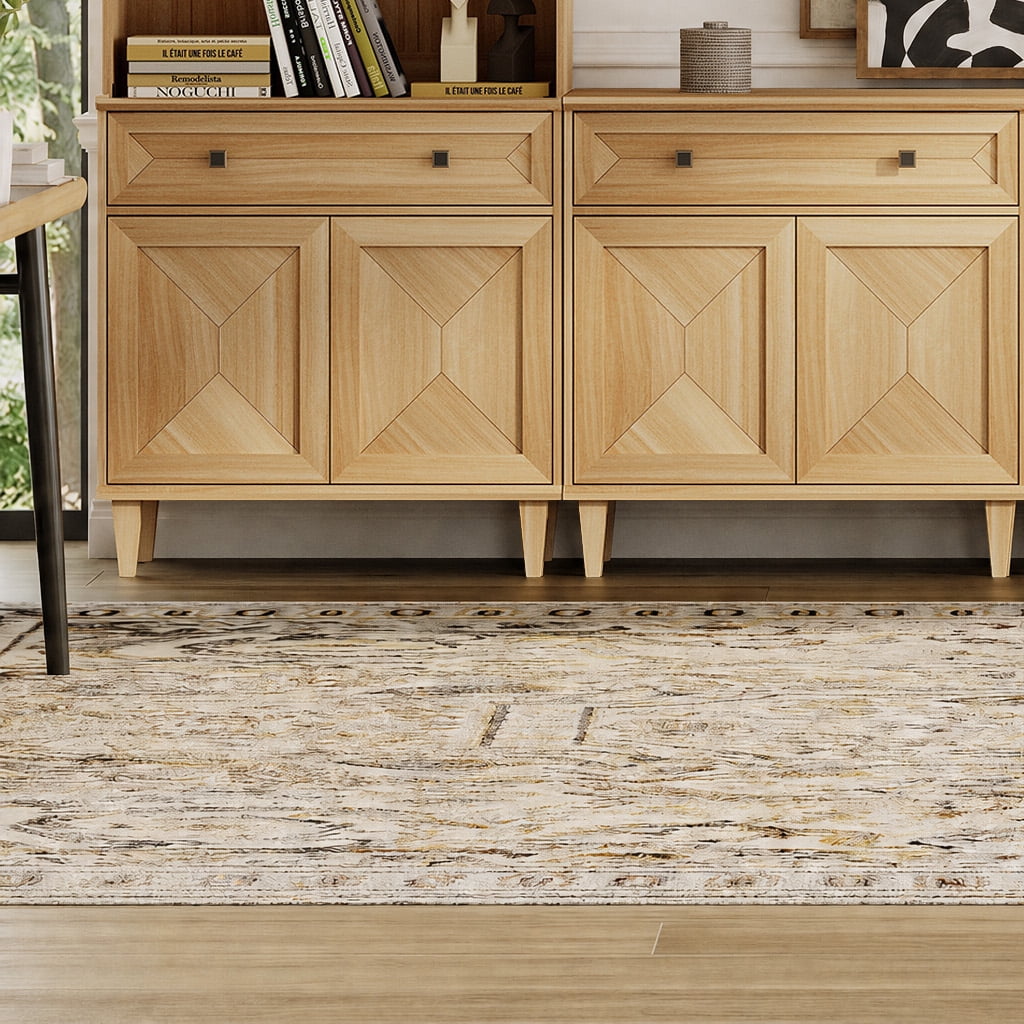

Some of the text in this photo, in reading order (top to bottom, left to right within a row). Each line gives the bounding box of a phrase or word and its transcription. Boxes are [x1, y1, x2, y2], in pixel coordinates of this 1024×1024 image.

[162, 48, 243, 58] IL ÉTAIT UNE FOIS LE CAFÉ
[171, 75, 222, 83] Remodelista
[156, 87, 235, 97] NOGUCHI
[452, 86, 469, 95] ÉTAIT
[506, 86, 523, 95] CAFÉ
